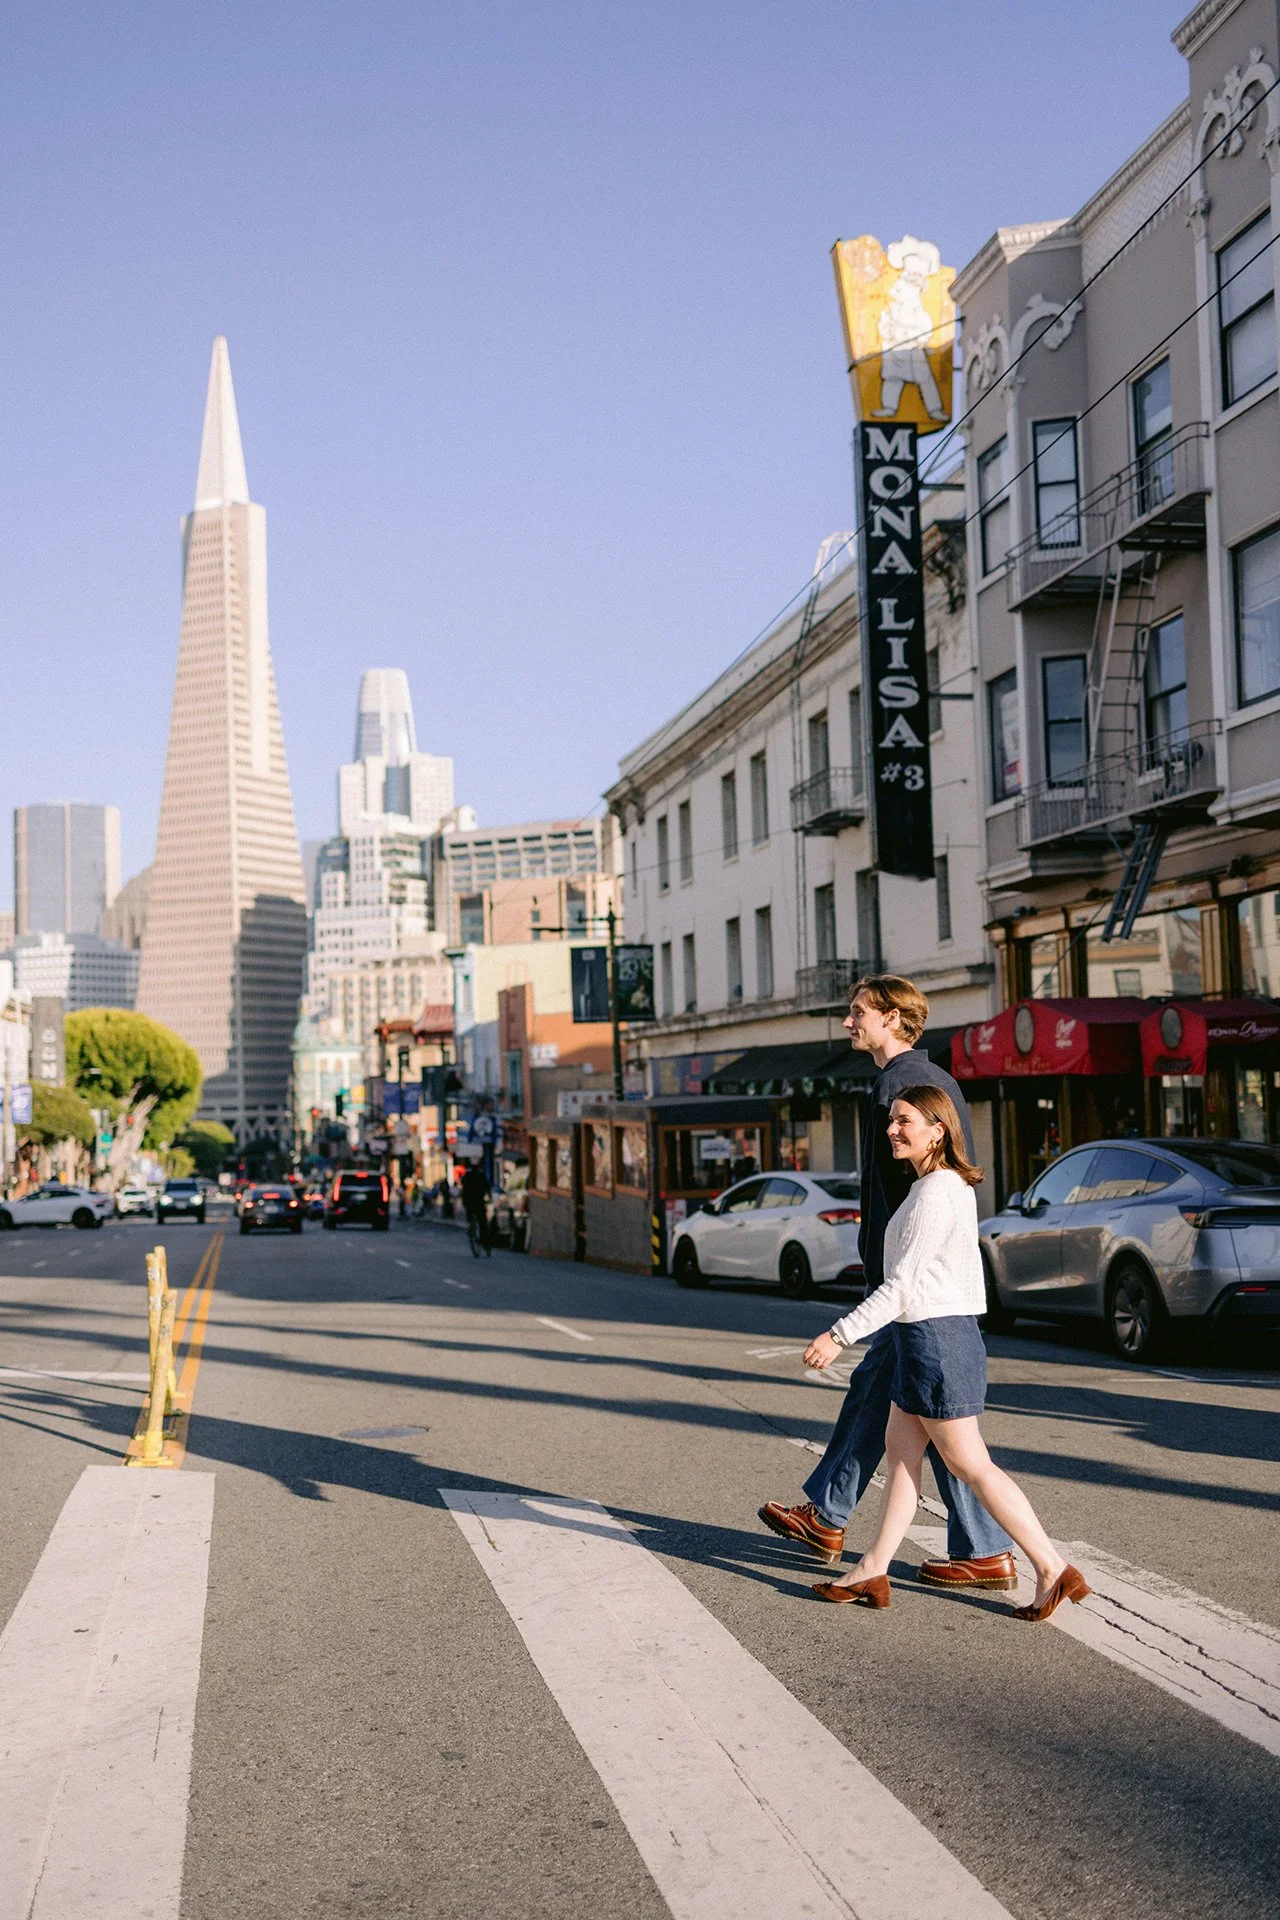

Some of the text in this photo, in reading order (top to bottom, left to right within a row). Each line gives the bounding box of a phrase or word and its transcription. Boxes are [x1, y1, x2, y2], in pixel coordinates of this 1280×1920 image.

[864, 426, 926, 791] MONA LISA #3
